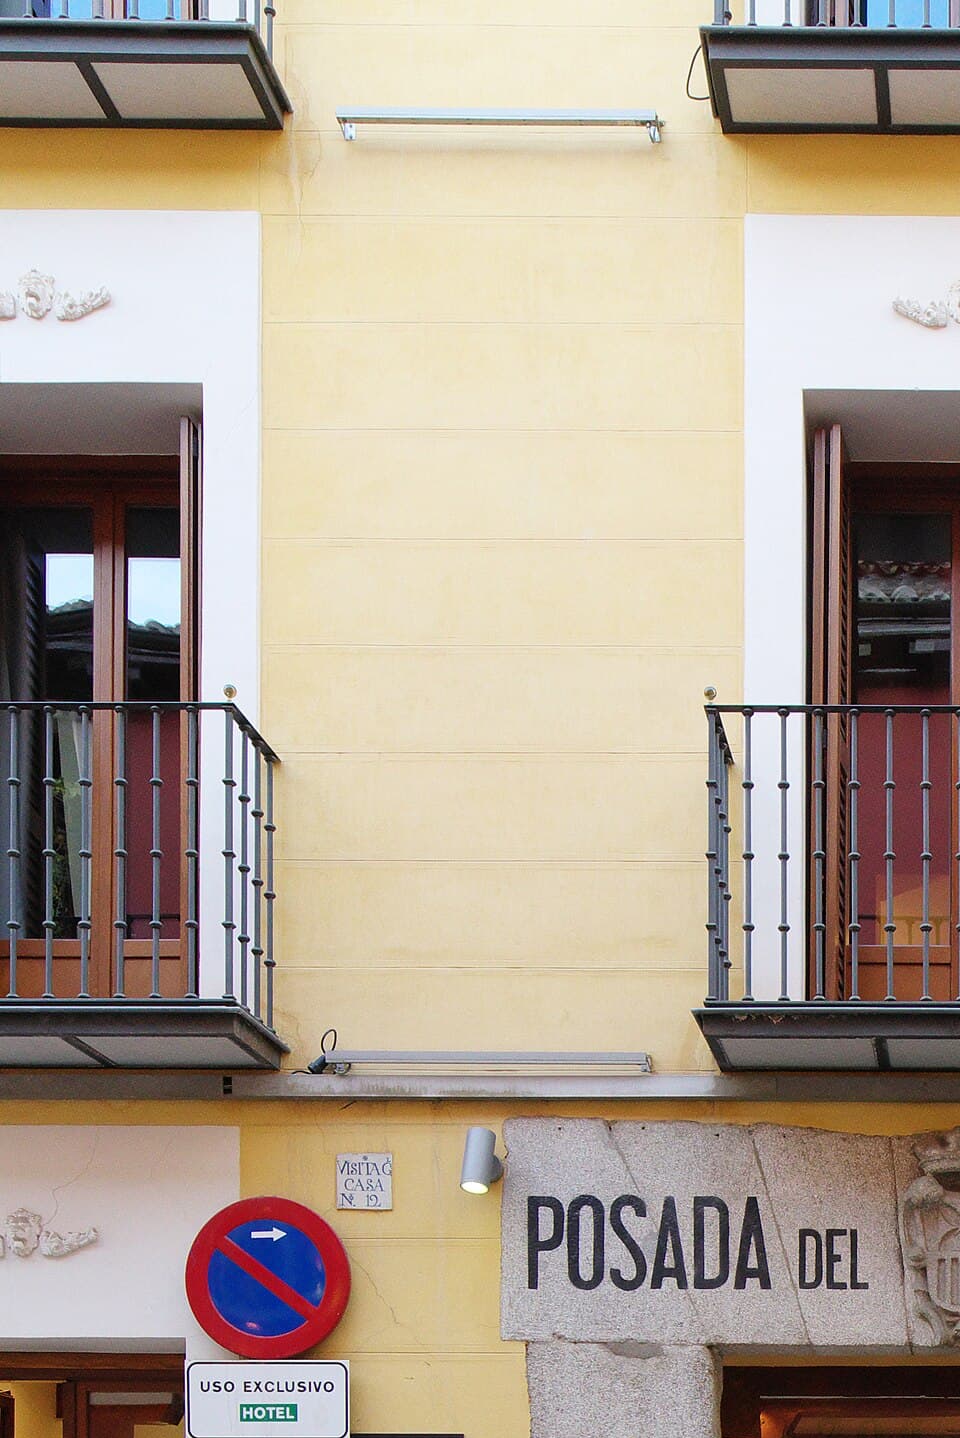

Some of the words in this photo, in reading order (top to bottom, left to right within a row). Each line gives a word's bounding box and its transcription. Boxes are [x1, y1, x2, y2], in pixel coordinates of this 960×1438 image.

[344, 1179, 384, 1191] CASA
[527, 1195, 772, 1290] POSADA
[800, 1228, 869, 1289] DEL
[200, 1381, 234, 1393] USO
[244, 1382, 334, 1393] EXCLUSIVO
[243, 1407, 294, 1418] HOTEL
